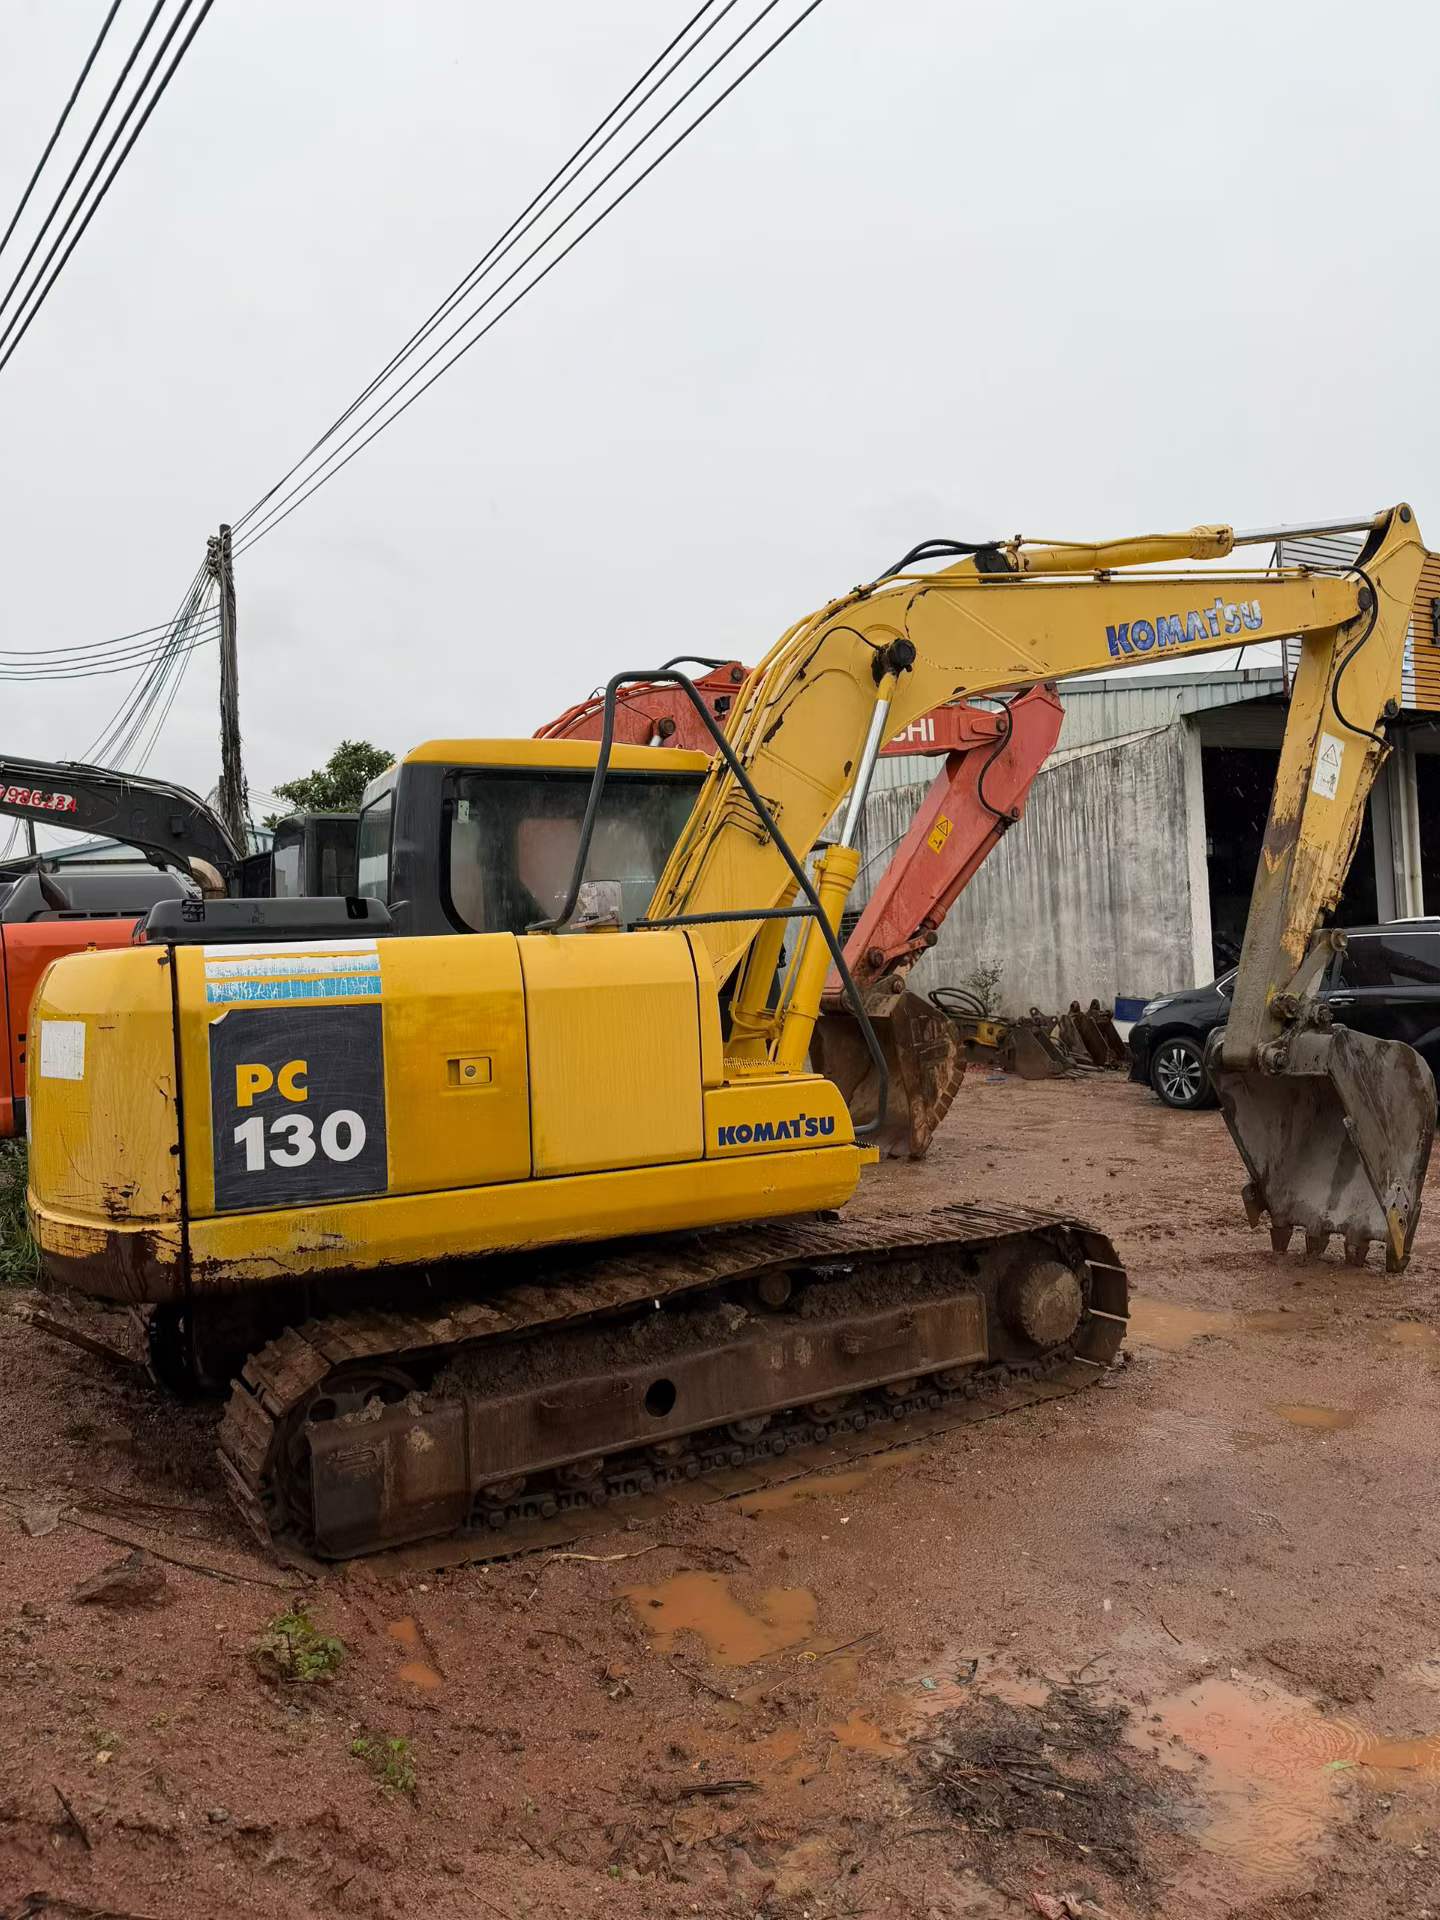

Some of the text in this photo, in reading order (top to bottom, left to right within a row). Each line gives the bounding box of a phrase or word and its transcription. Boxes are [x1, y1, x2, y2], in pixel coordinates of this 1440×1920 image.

[1105, 597, 1263, 657] KOMATSU
[236, 1059, 308, 1107] PC
[234, 1109, 367, 1172] 130
[718, 1113, 835, 1146] KOMATSU
